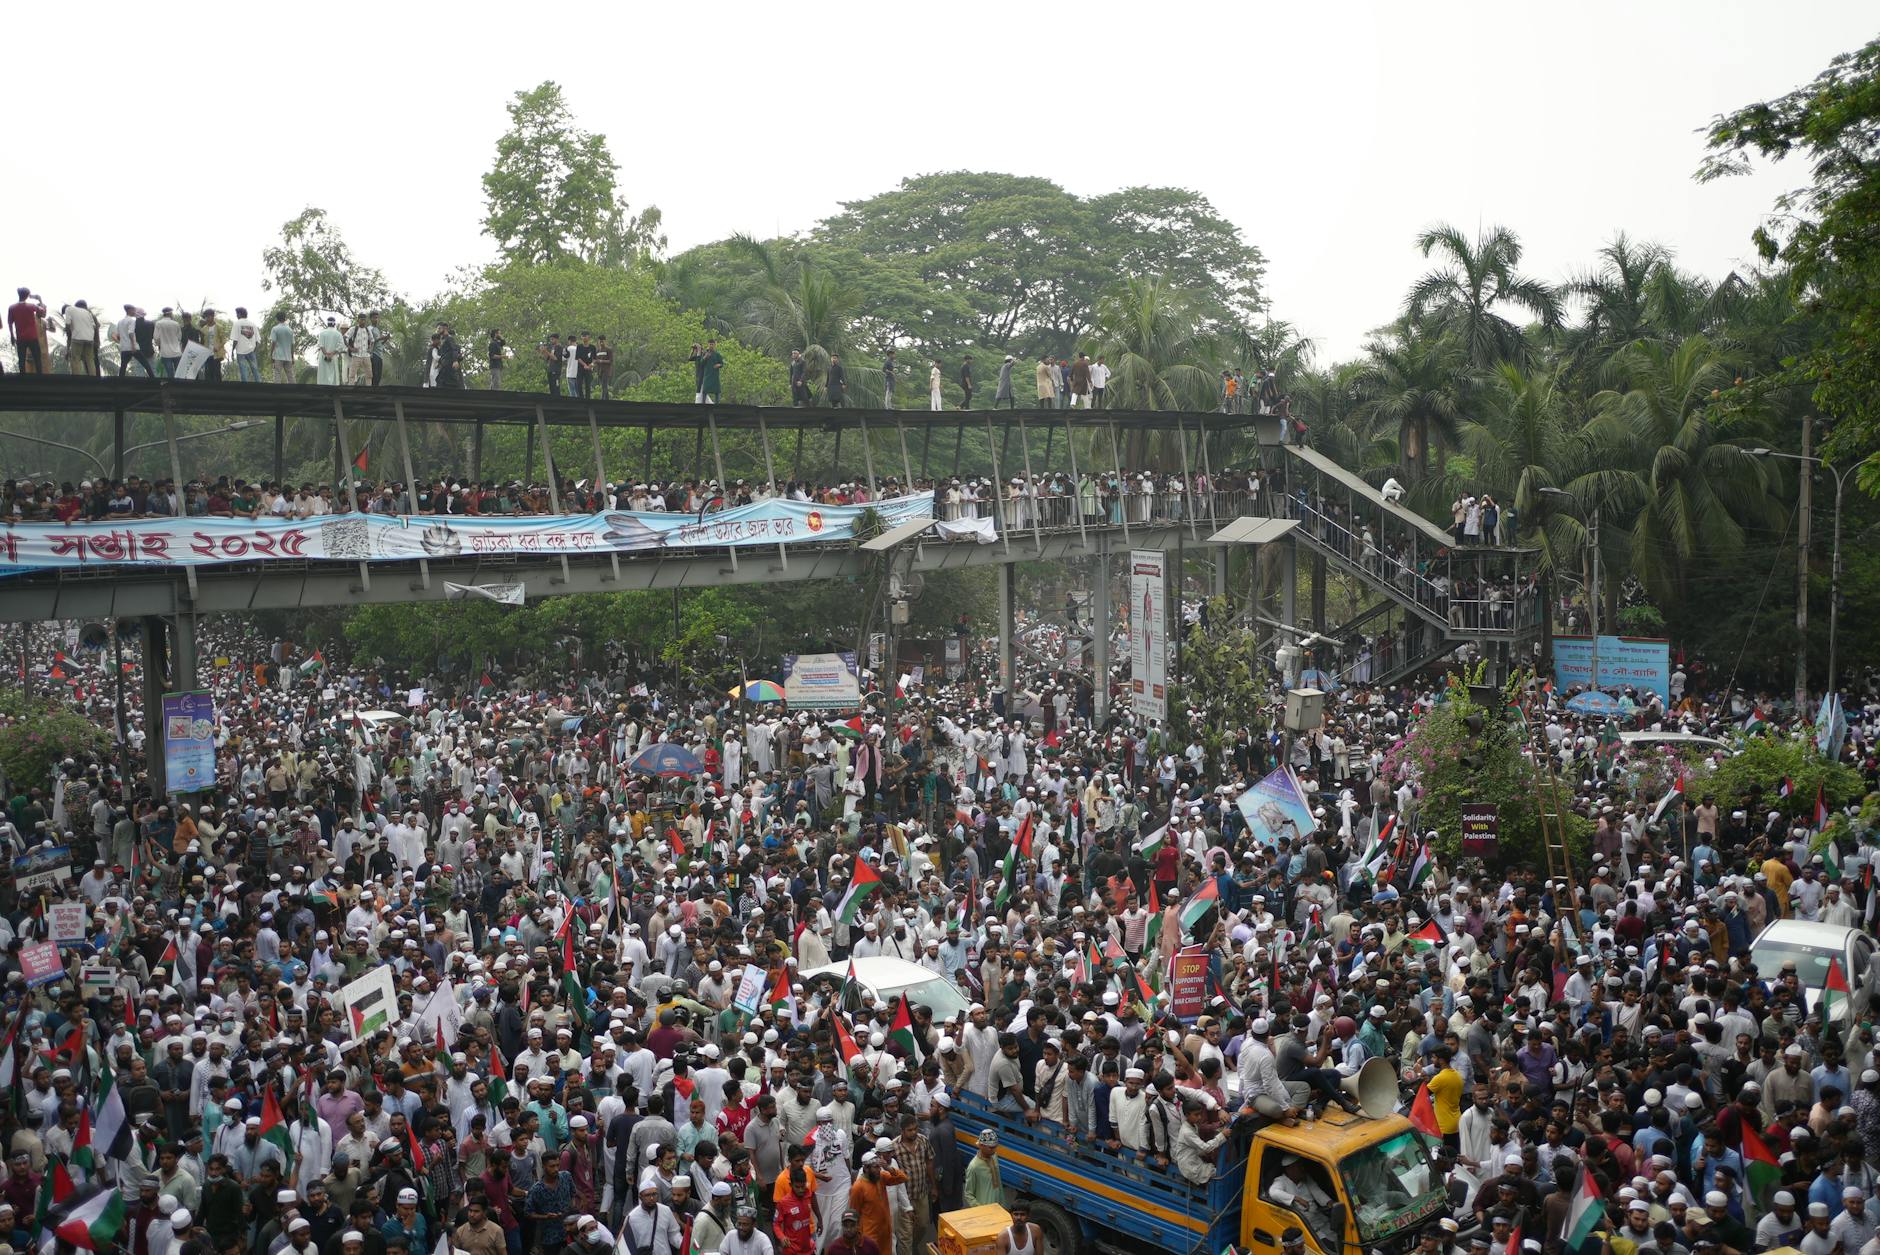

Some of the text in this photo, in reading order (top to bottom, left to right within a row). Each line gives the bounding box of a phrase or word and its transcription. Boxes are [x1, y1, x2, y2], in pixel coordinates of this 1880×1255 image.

[713, 520, 743, 540] উঠবে
[746, 519, 770, 537] জাল
[772, 517, 794, 536] ভরে
[43, 529, 175, 562] সপ্তাহ
[190, 529, 311, 560] ২০২৫
[469, 529, 597, 552] জাটকা ধরা বন্ধ হলে
[1182, 964, 1200, 974] STOP
[1175, 976, 1204, 984] SUPPORTING
[1393, 1212, 1418, 1226] TATA
